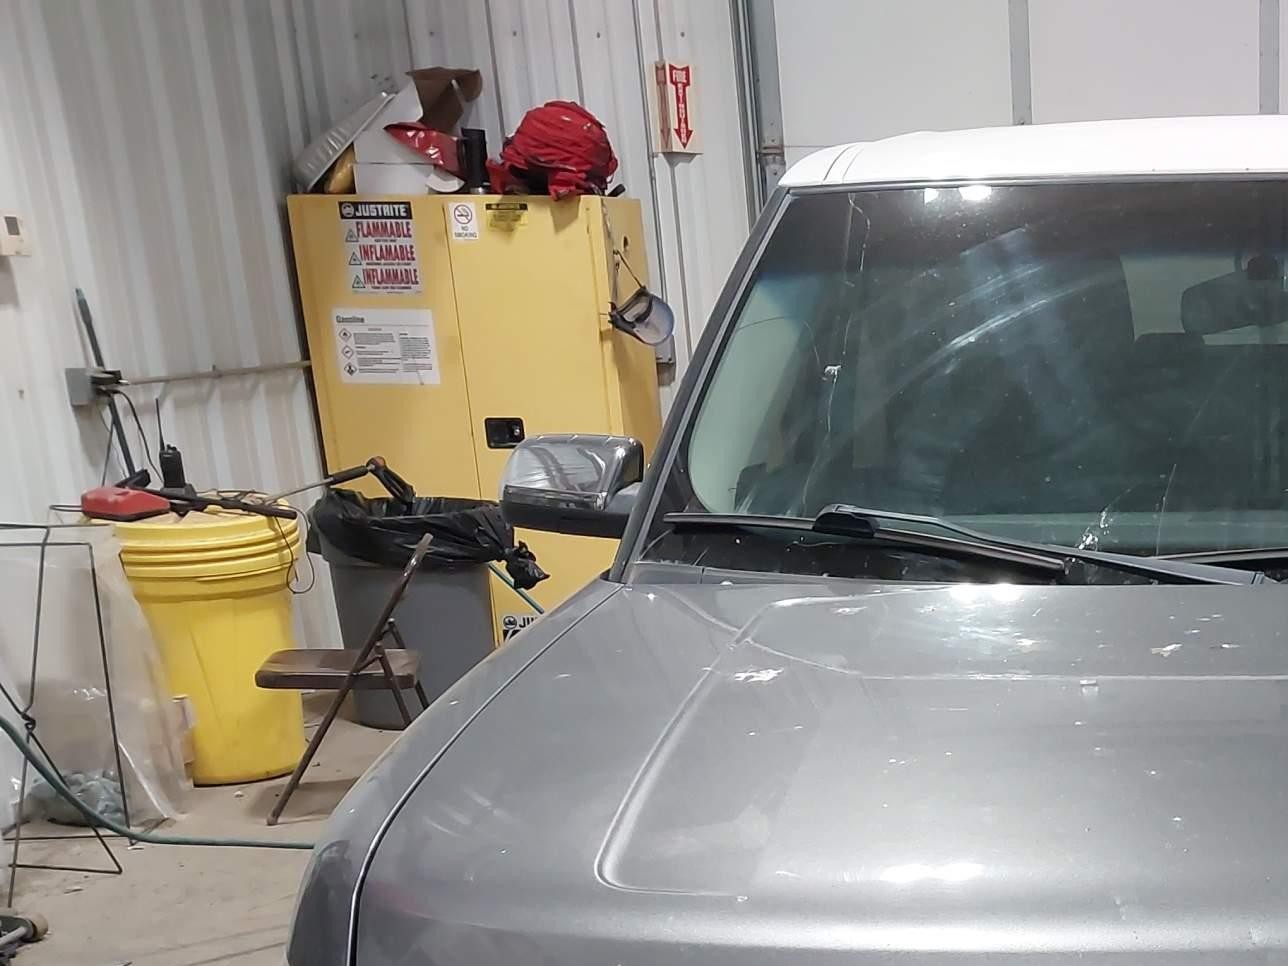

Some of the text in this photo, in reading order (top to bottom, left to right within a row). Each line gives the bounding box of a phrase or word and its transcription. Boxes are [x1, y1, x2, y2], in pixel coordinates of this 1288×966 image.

[355, 204, 408, 217] JUSTRITE
[355, 221, 412, 238] FLAMMABLE
[359, 244, 416, 261] INFLAMABLE
[362, 268, 420, 285] INFLAMMABLE
